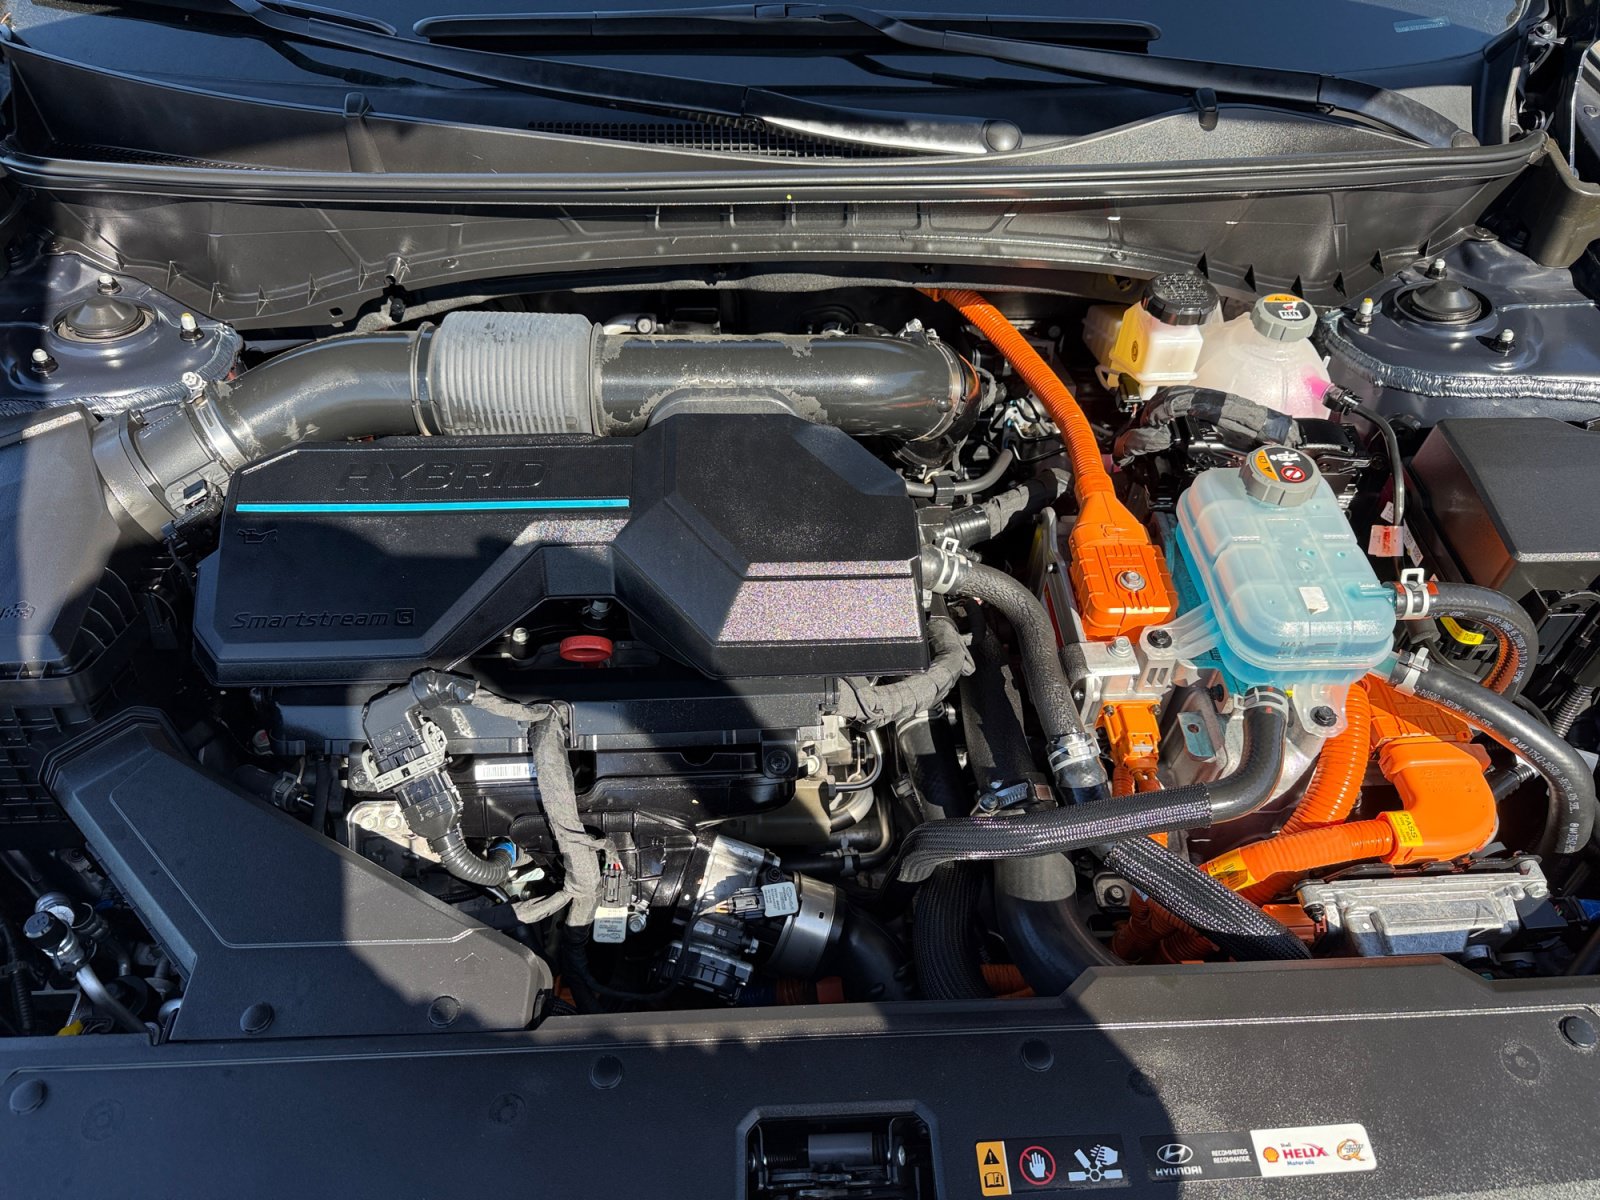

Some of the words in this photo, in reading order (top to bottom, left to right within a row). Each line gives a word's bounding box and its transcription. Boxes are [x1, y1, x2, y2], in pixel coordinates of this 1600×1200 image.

[337, 461, 548, 490] HYBRID
[230, 610, 388, 630] Smartstream
[1282, 1146, 1329, 1159] HELIX
[1155, 1165, 1203, 1177] HYUNDAI
